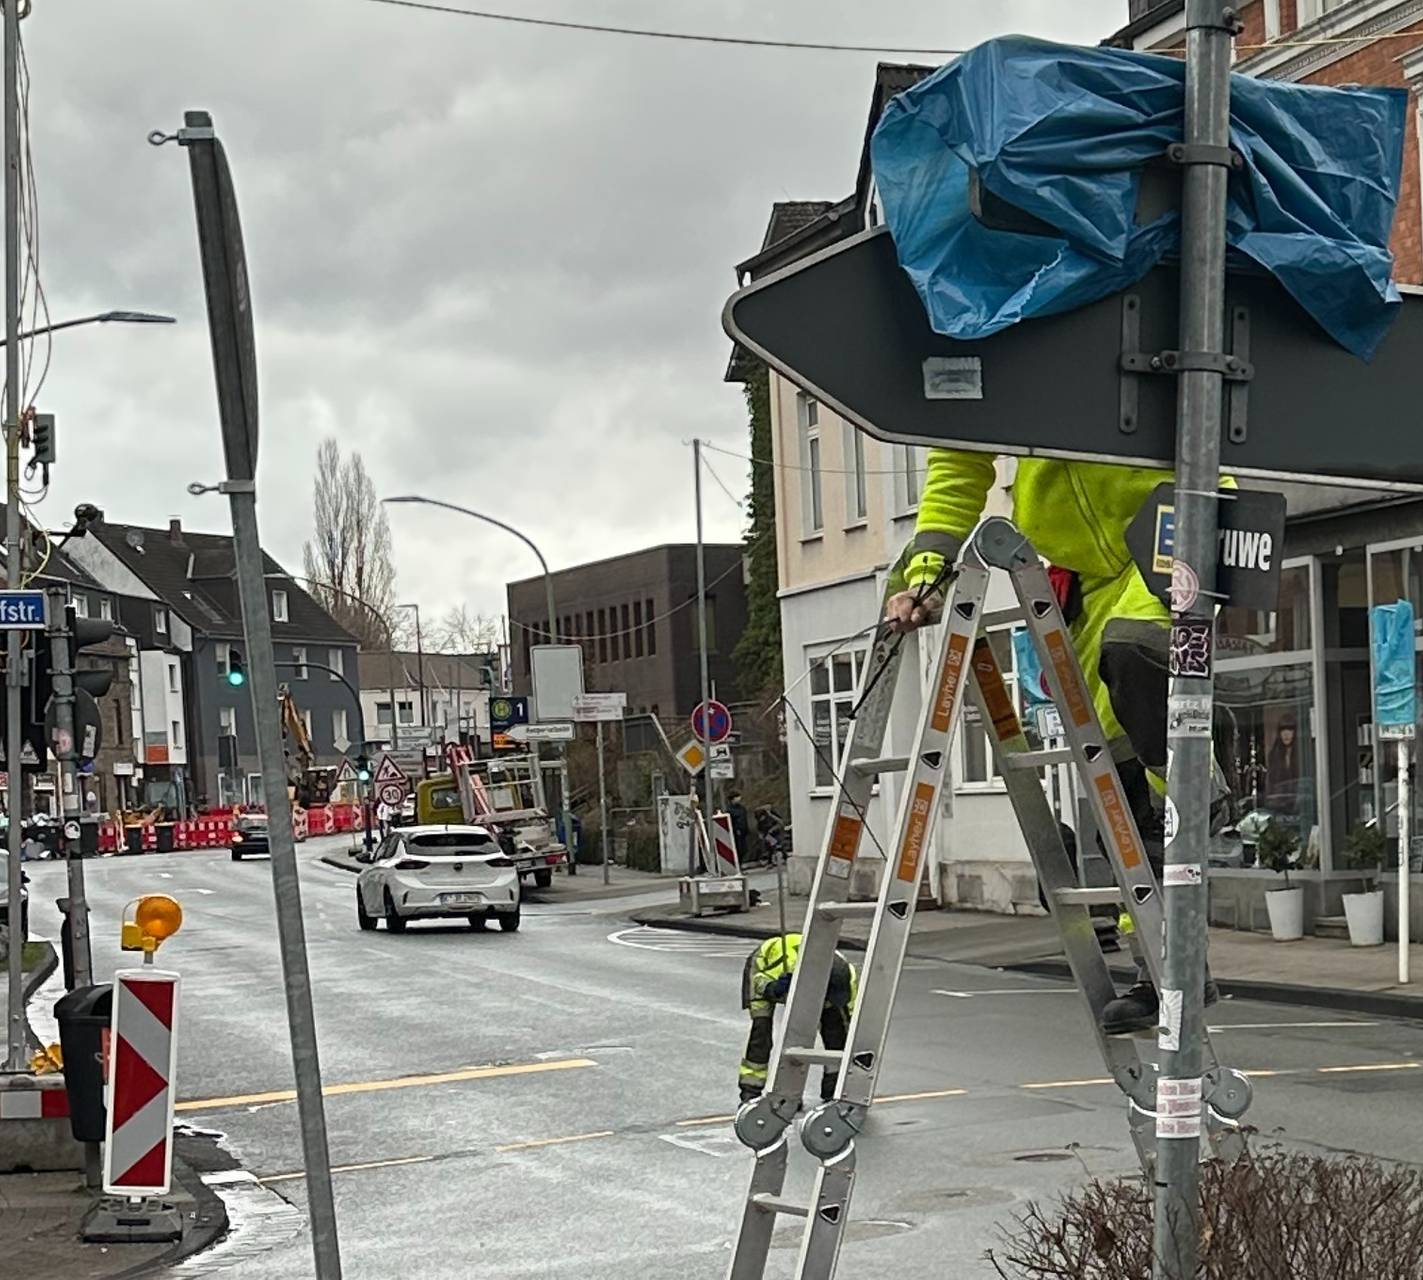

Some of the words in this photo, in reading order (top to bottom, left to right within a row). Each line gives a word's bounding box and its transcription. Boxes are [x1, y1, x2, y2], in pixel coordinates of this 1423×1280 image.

[936, 670, 956, 716] Layher
[385, 788, 399, 800] 30
[903, 819, 922, 866] Layher
